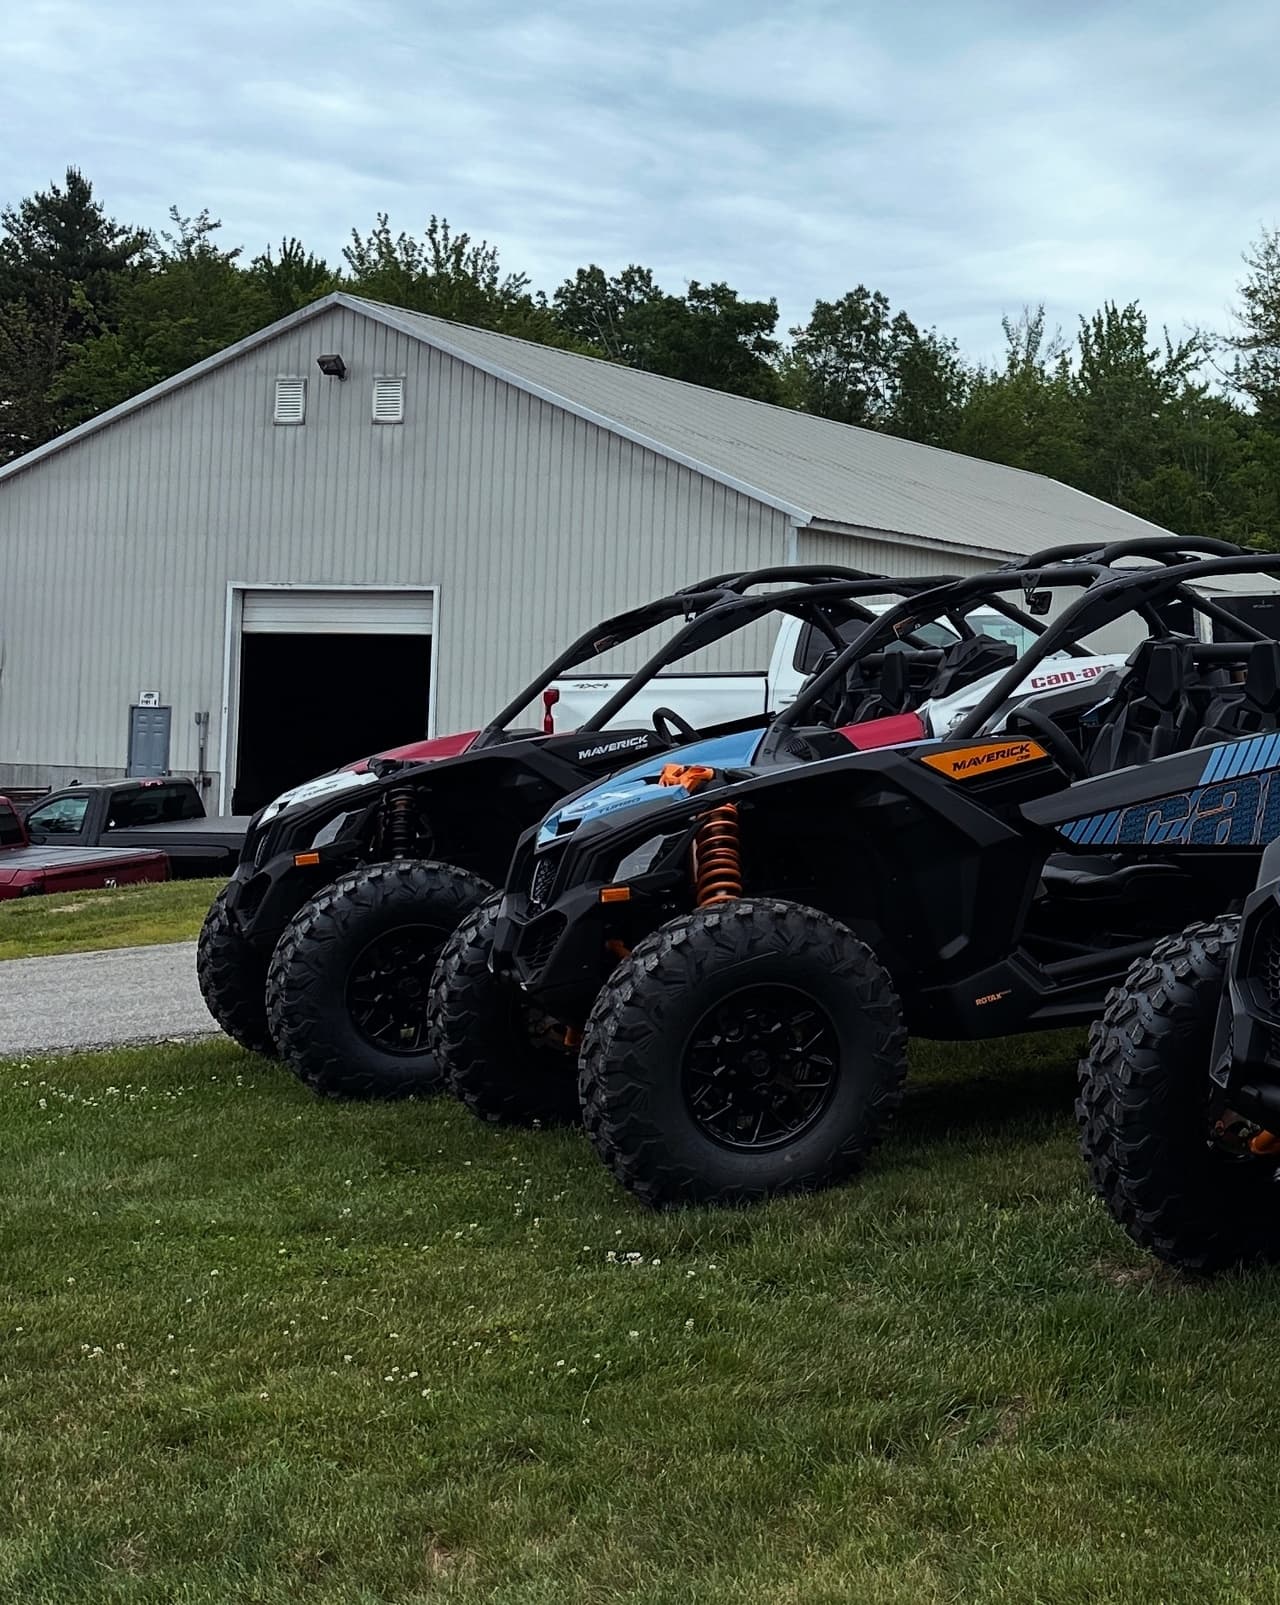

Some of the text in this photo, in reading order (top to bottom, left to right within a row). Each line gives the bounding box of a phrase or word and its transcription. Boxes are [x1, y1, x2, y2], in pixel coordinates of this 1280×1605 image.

[578, 734, 648, 760] MAVERICK
[952, 743, 1030, 772] MAVERICK
[976, 993, 1002, 1006] ROTAX
